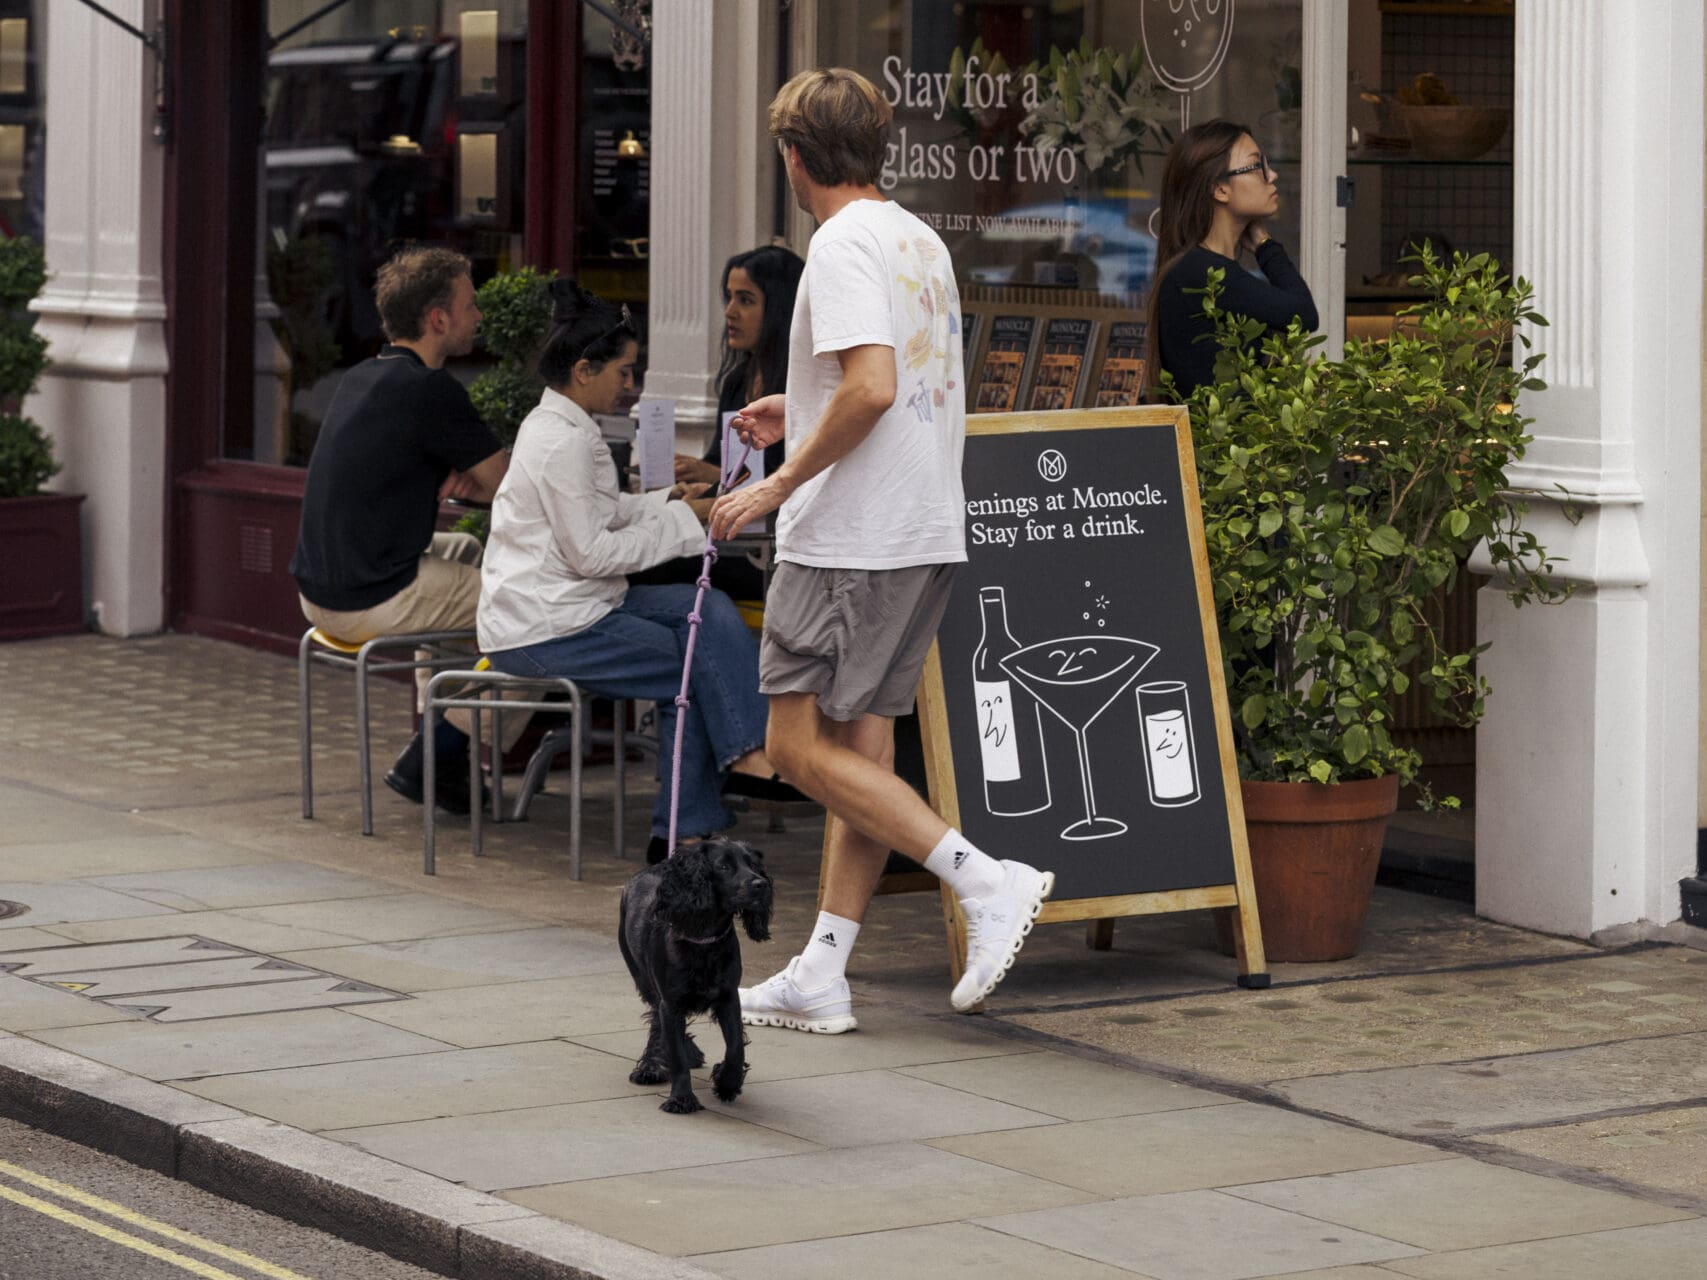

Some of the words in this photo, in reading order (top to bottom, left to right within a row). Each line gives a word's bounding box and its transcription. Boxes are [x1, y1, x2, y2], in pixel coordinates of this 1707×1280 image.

[882, 55, 952, 120] Stay
[962, 55, 1011, 109] for
[1022, 72, 1040, 110] a
[879, 126, 956, 191] glass
[968, 145, 1004, 181] or
[1014, 141, 1077, 184] two
[946, 213, 973, 231] LIST
[976, 215, 1007, 233] NOW
[964, 493, 1039, 518] enings
[1046, 493, 1066, 511] at
[1072, 484, 1168, 510] Monocle.
[971, 522, 1018, 548] Stay
[1025, 519, 1056, 541] for
[1063, 523, 1075, 539] a
[1081, 513, 1145, 538] drink.
